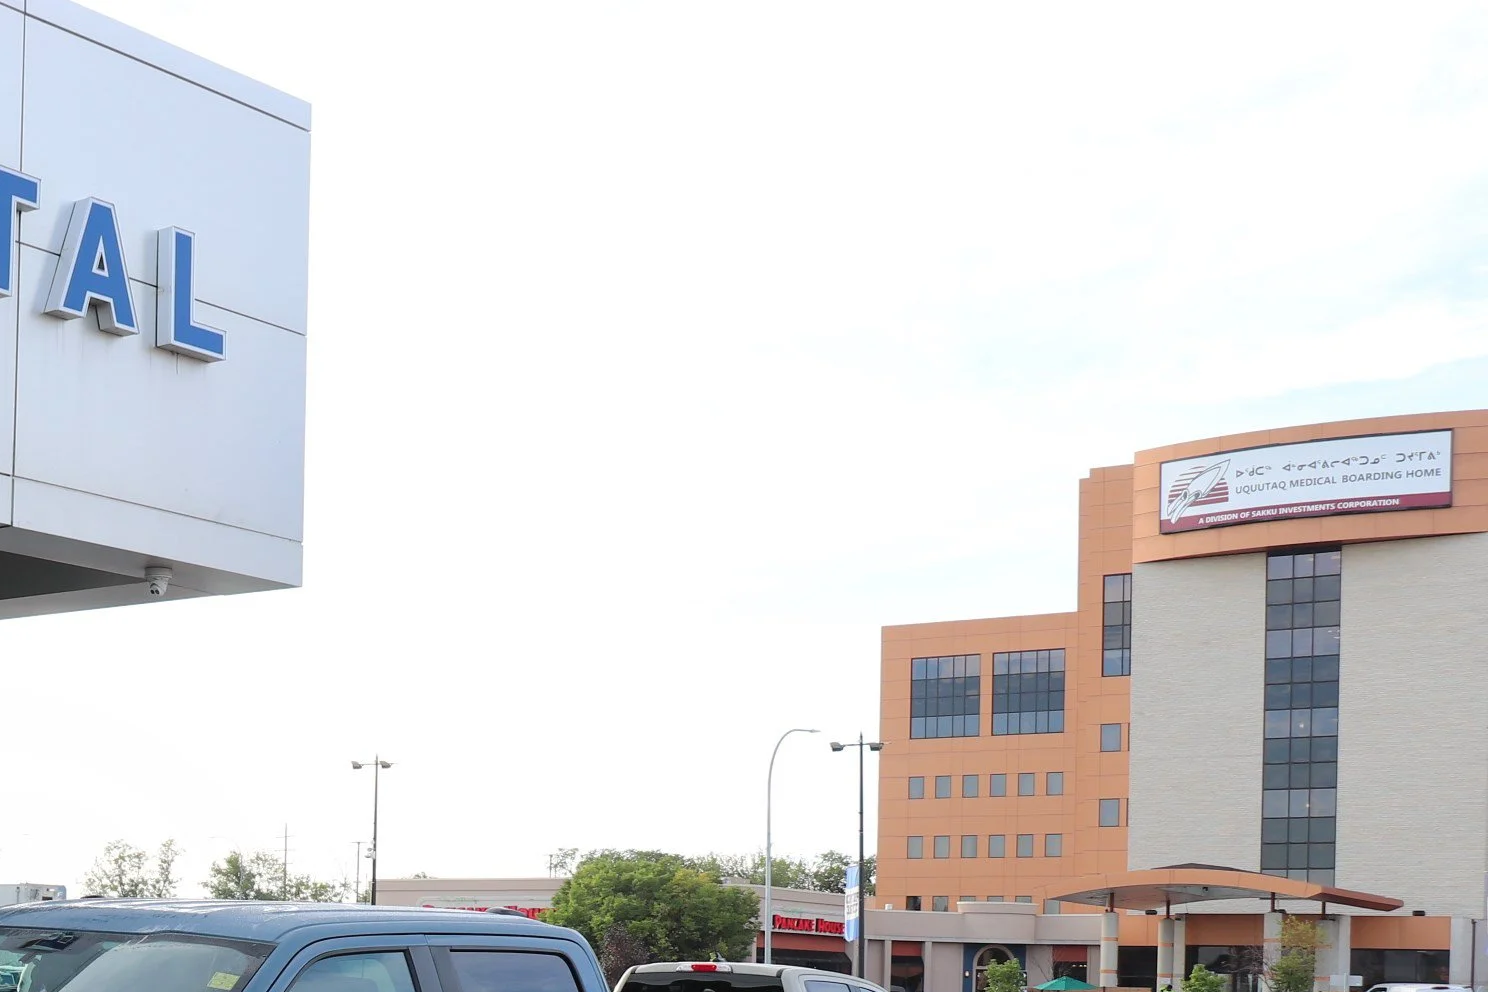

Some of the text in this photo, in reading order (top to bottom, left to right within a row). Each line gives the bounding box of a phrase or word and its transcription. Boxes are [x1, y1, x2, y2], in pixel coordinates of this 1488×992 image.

[1235, 467, 1441, 495] UQUUTAQ MEDICAL BOARDING HOME
[1198, 498, 1400, 525] A DIVISION OF SAKKU INVESTMENTS CORPORATION
